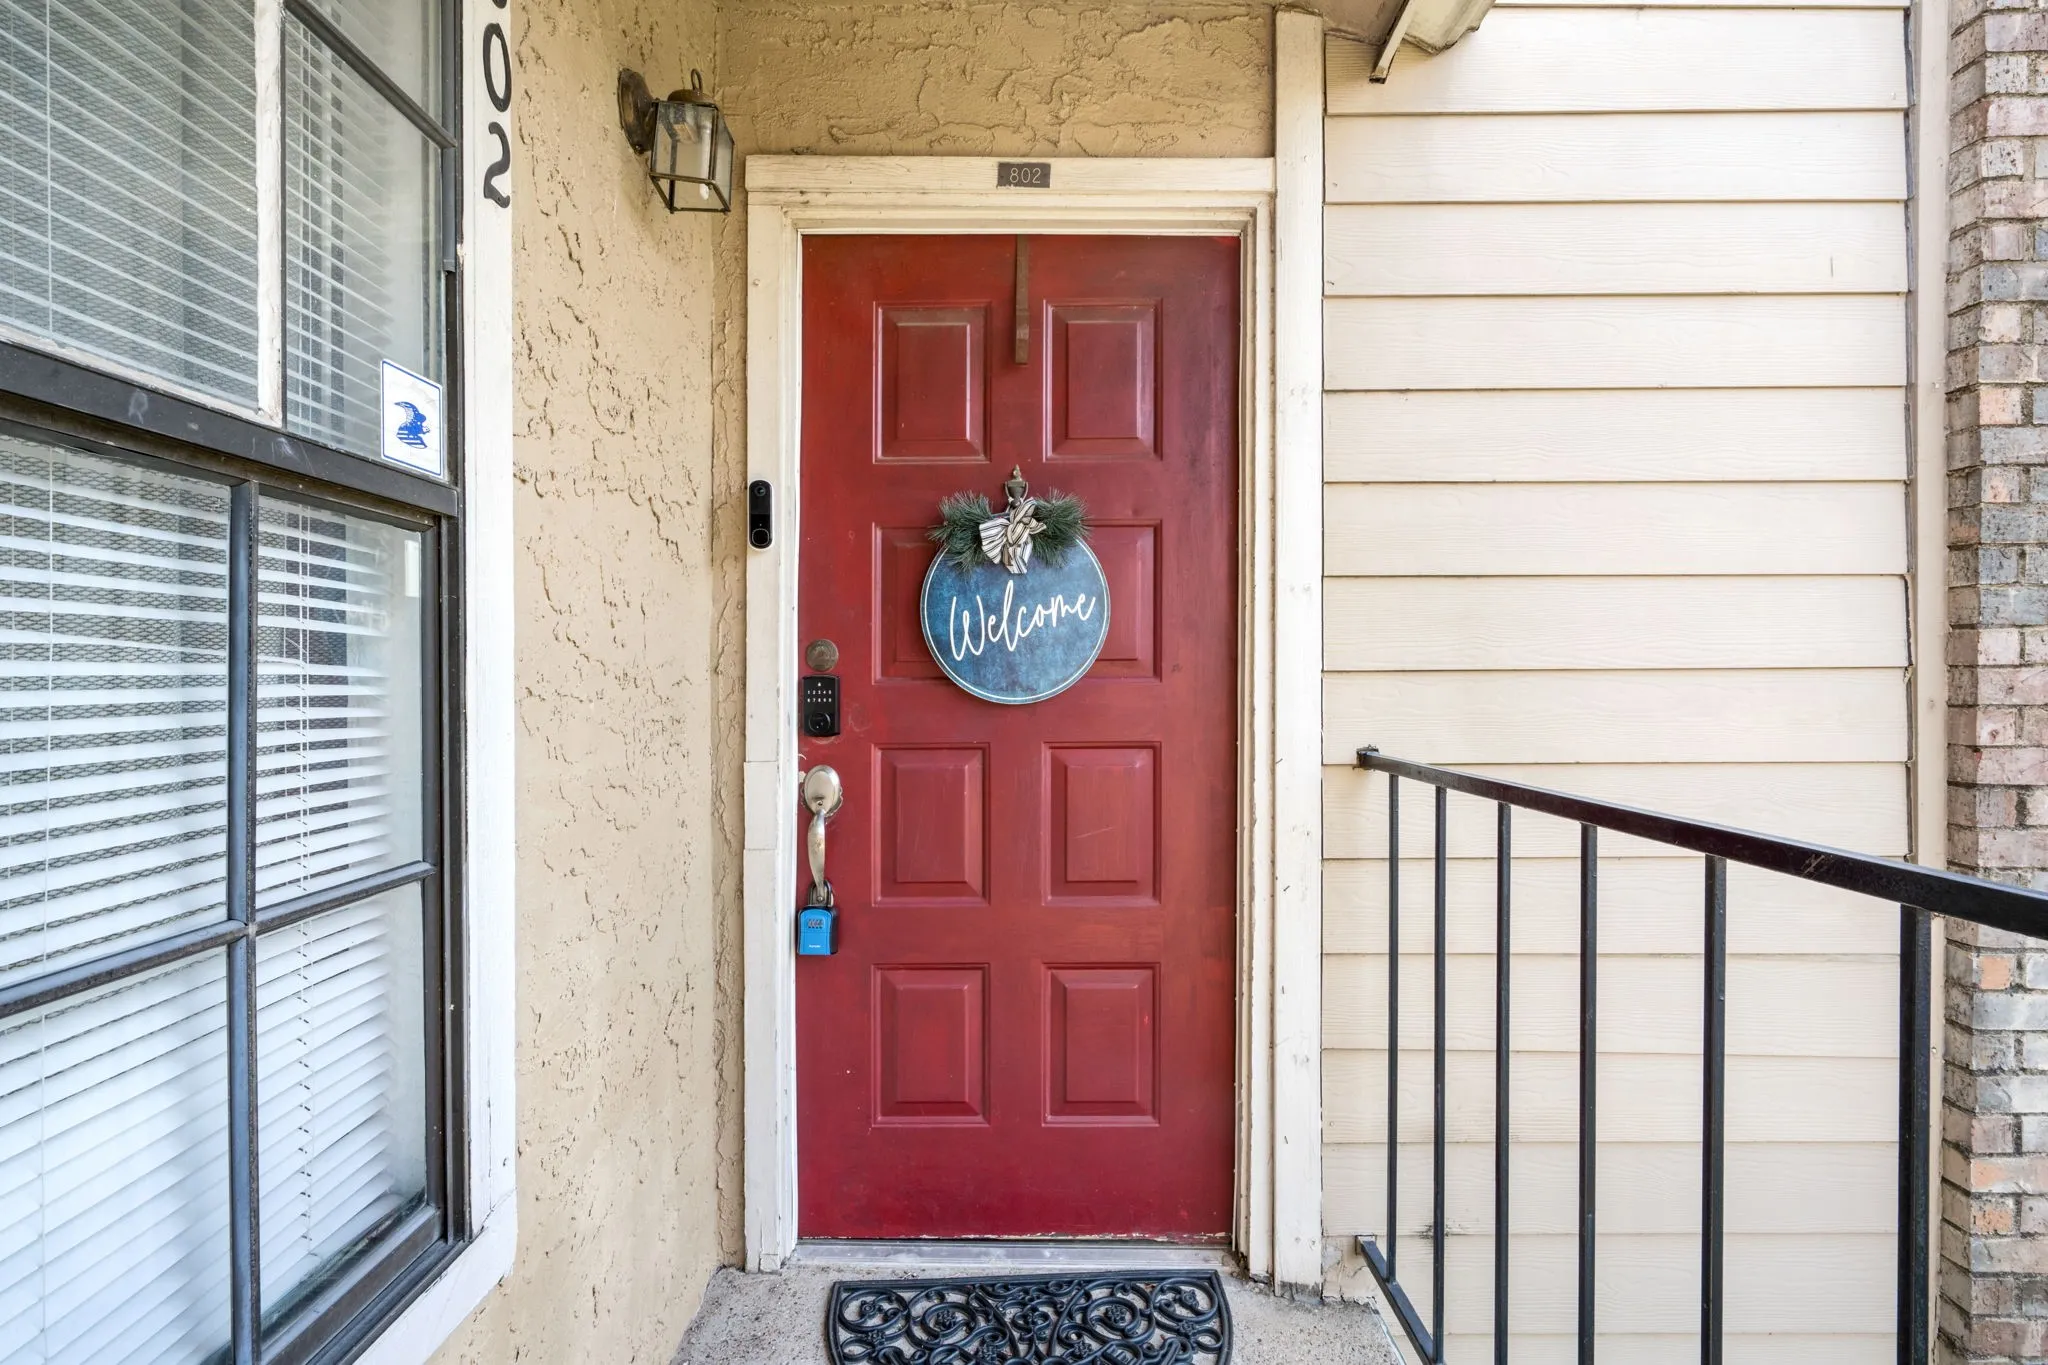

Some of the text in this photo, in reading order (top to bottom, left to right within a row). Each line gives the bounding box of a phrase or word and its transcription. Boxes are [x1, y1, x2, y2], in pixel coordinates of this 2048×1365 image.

[483, 0, 511, 208] 02
[1010, 168, 1041, 183] 802
[950, 580, 1096, 661] Welcome
